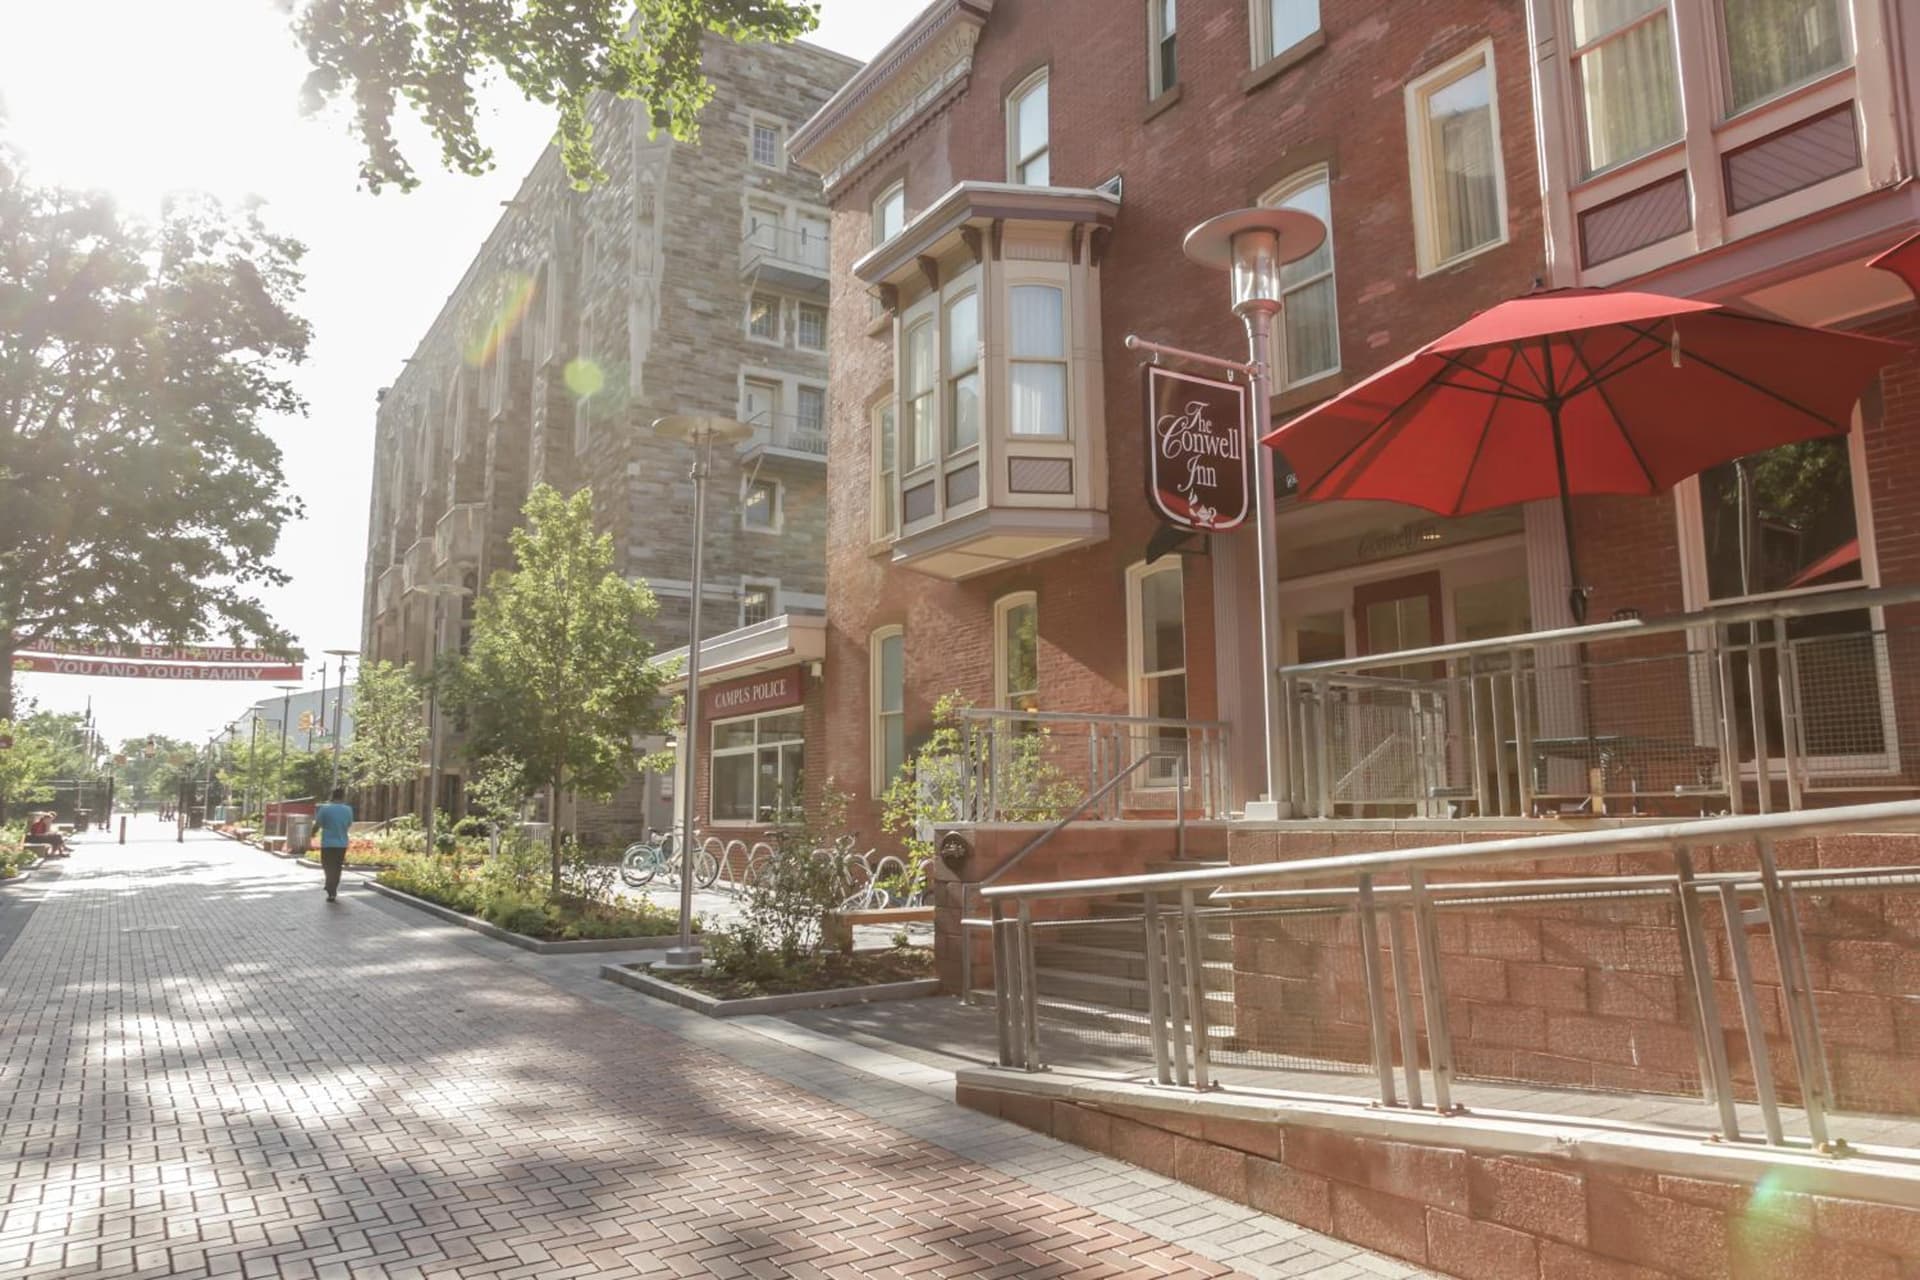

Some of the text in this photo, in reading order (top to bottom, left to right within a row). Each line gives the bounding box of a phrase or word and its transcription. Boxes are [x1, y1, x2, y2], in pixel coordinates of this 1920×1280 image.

[1185, 401, 1213, 434] The
[1157, 414, 1241, 460] Conwell
[1177, 454, 1218, 492] Inn
[53, 660, 263, 680] YOU AND YOUR FAMILY
[715, 679, 787, 708] CAMPUS POLICE
